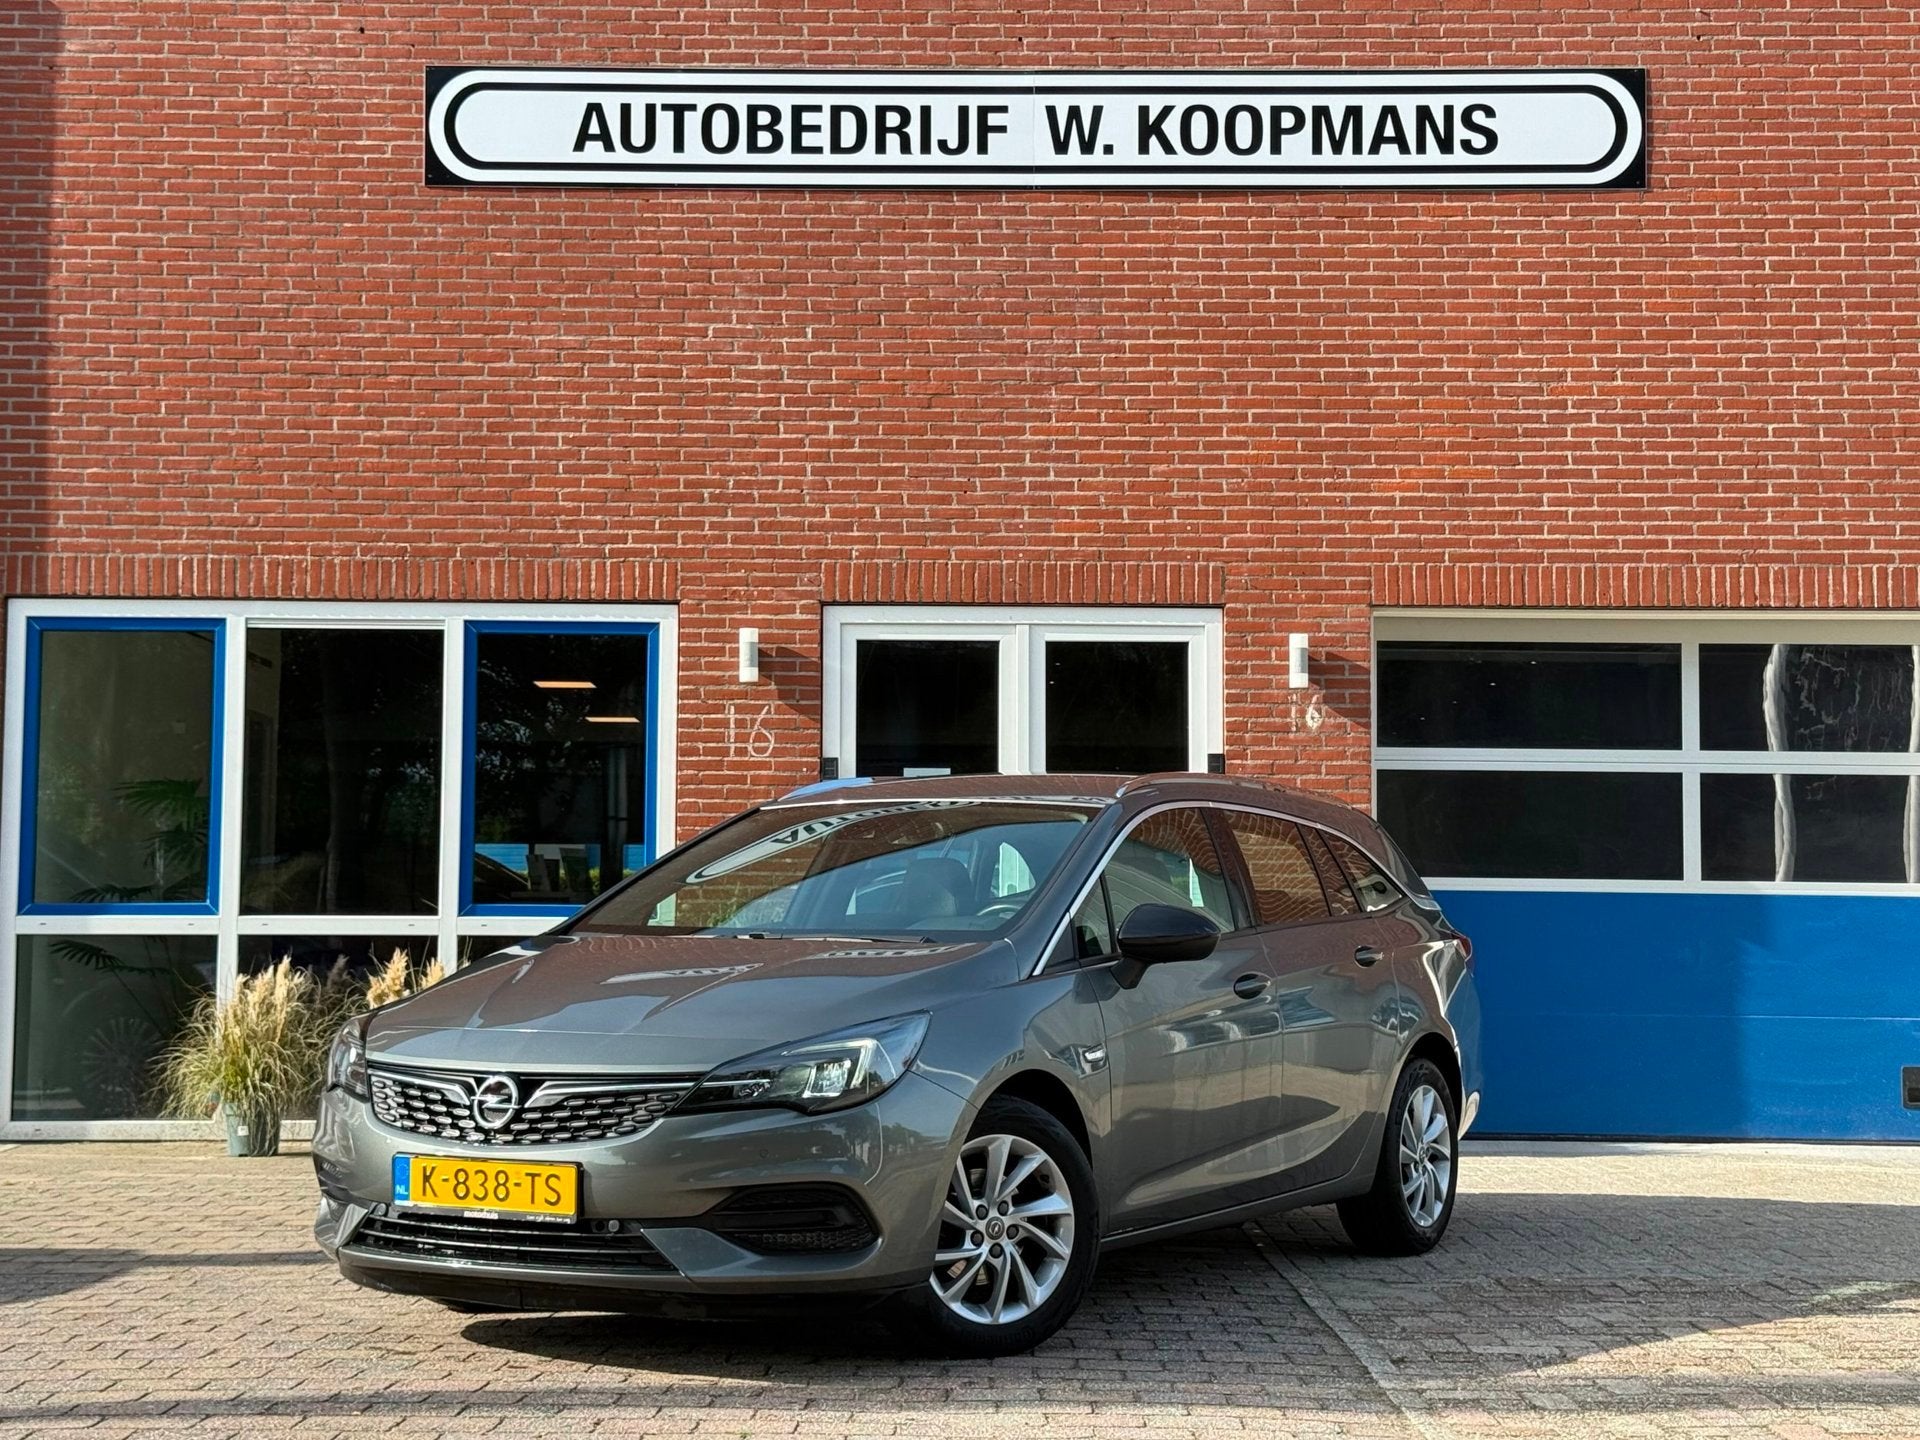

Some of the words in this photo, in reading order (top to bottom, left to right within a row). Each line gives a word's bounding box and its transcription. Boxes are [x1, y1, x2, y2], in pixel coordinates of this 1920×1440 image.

[572, 102, 1009, 156] AUTOBEDRIJF
[1045, 104, 1114, 156] W.
[1138, 103, 1499, 156] KOOPMANS
[730, 704, 774, 757] 16
[1290, 693, 1322, 730] 16
[395, 1184, 408, 1195] NL
[421, 1164, 562, 1207] K-838-TS
